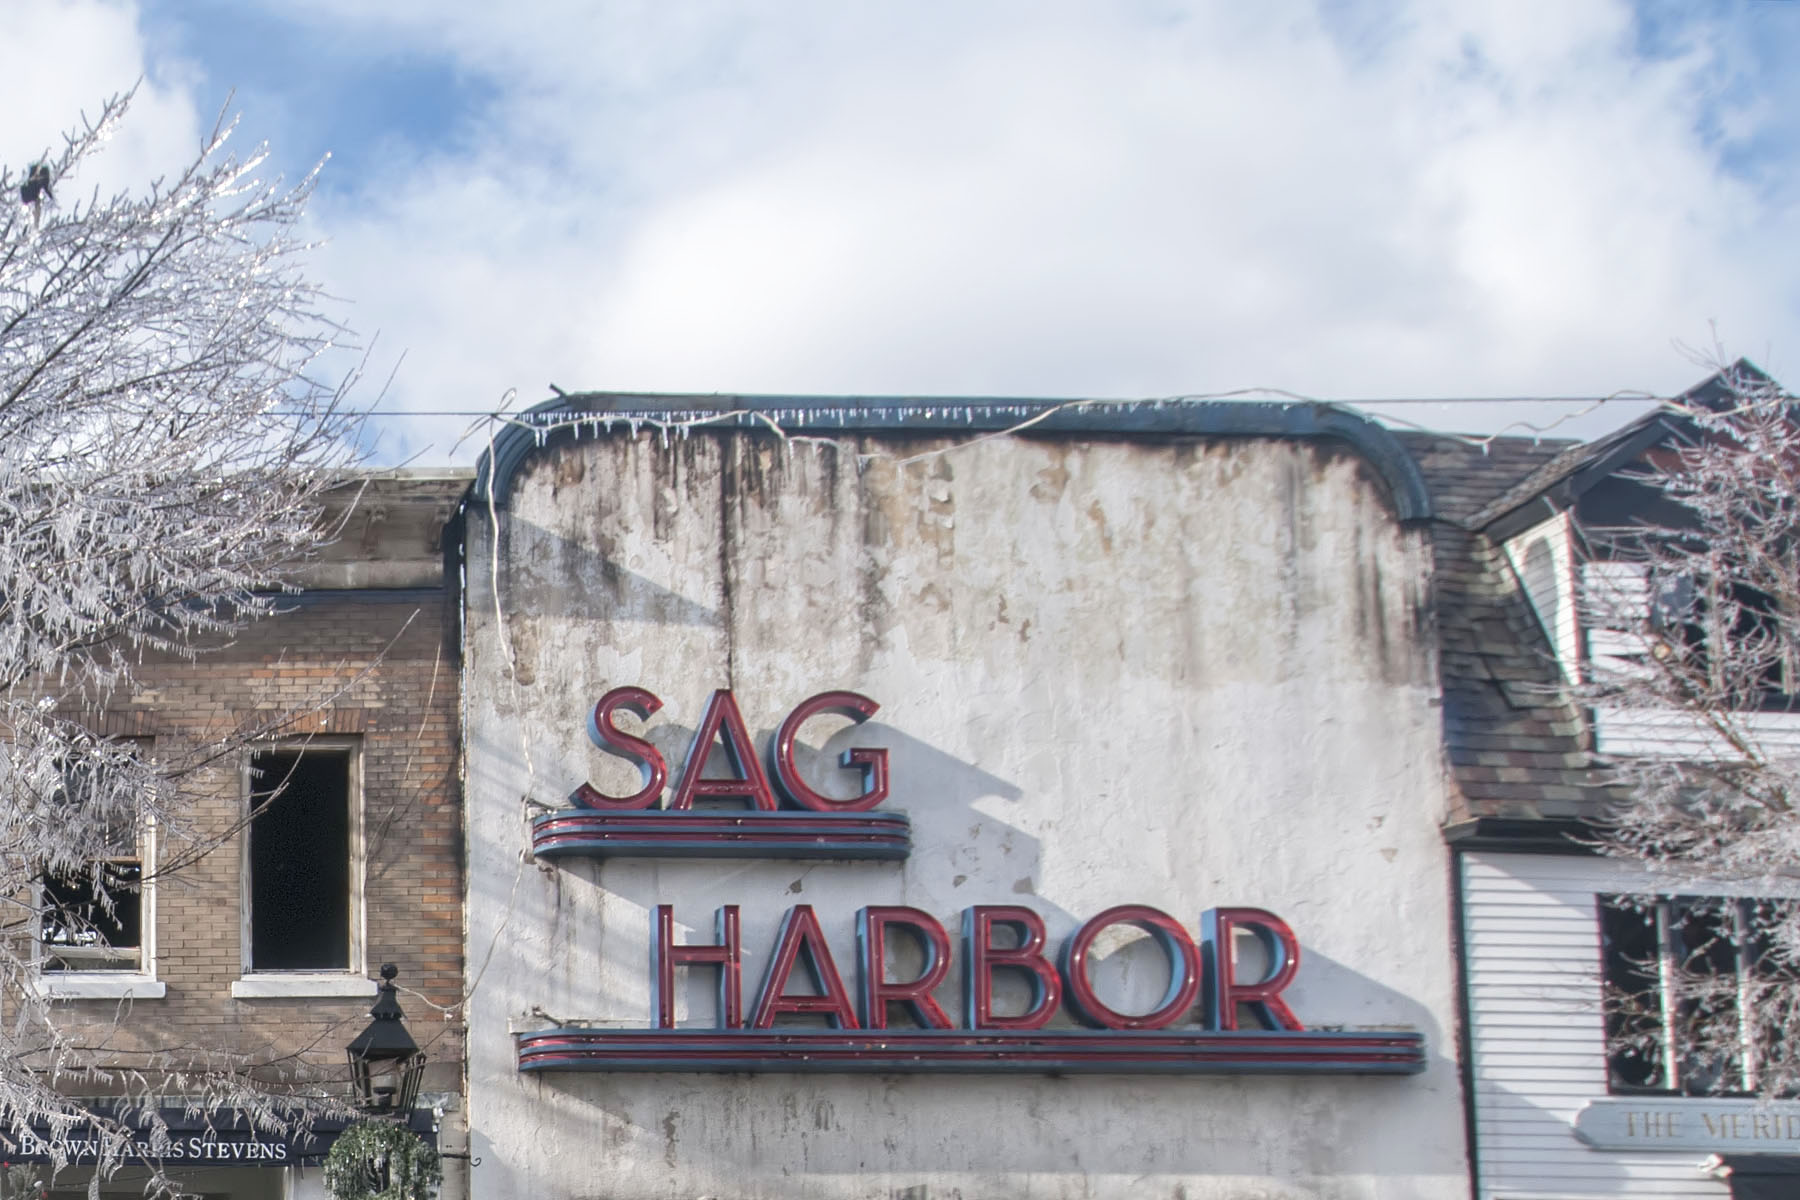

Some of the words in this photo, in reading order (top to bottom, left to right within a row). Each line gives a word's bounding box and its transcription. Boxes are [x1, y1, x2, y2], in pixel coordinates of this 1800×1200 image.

[569, 686, 890, 812] SAG
[650, 904, 1302, 1032] HARBOR
[188, 1138, 287, 1160] STEVENS
[1622, 1111, 1684, 1137] THE
